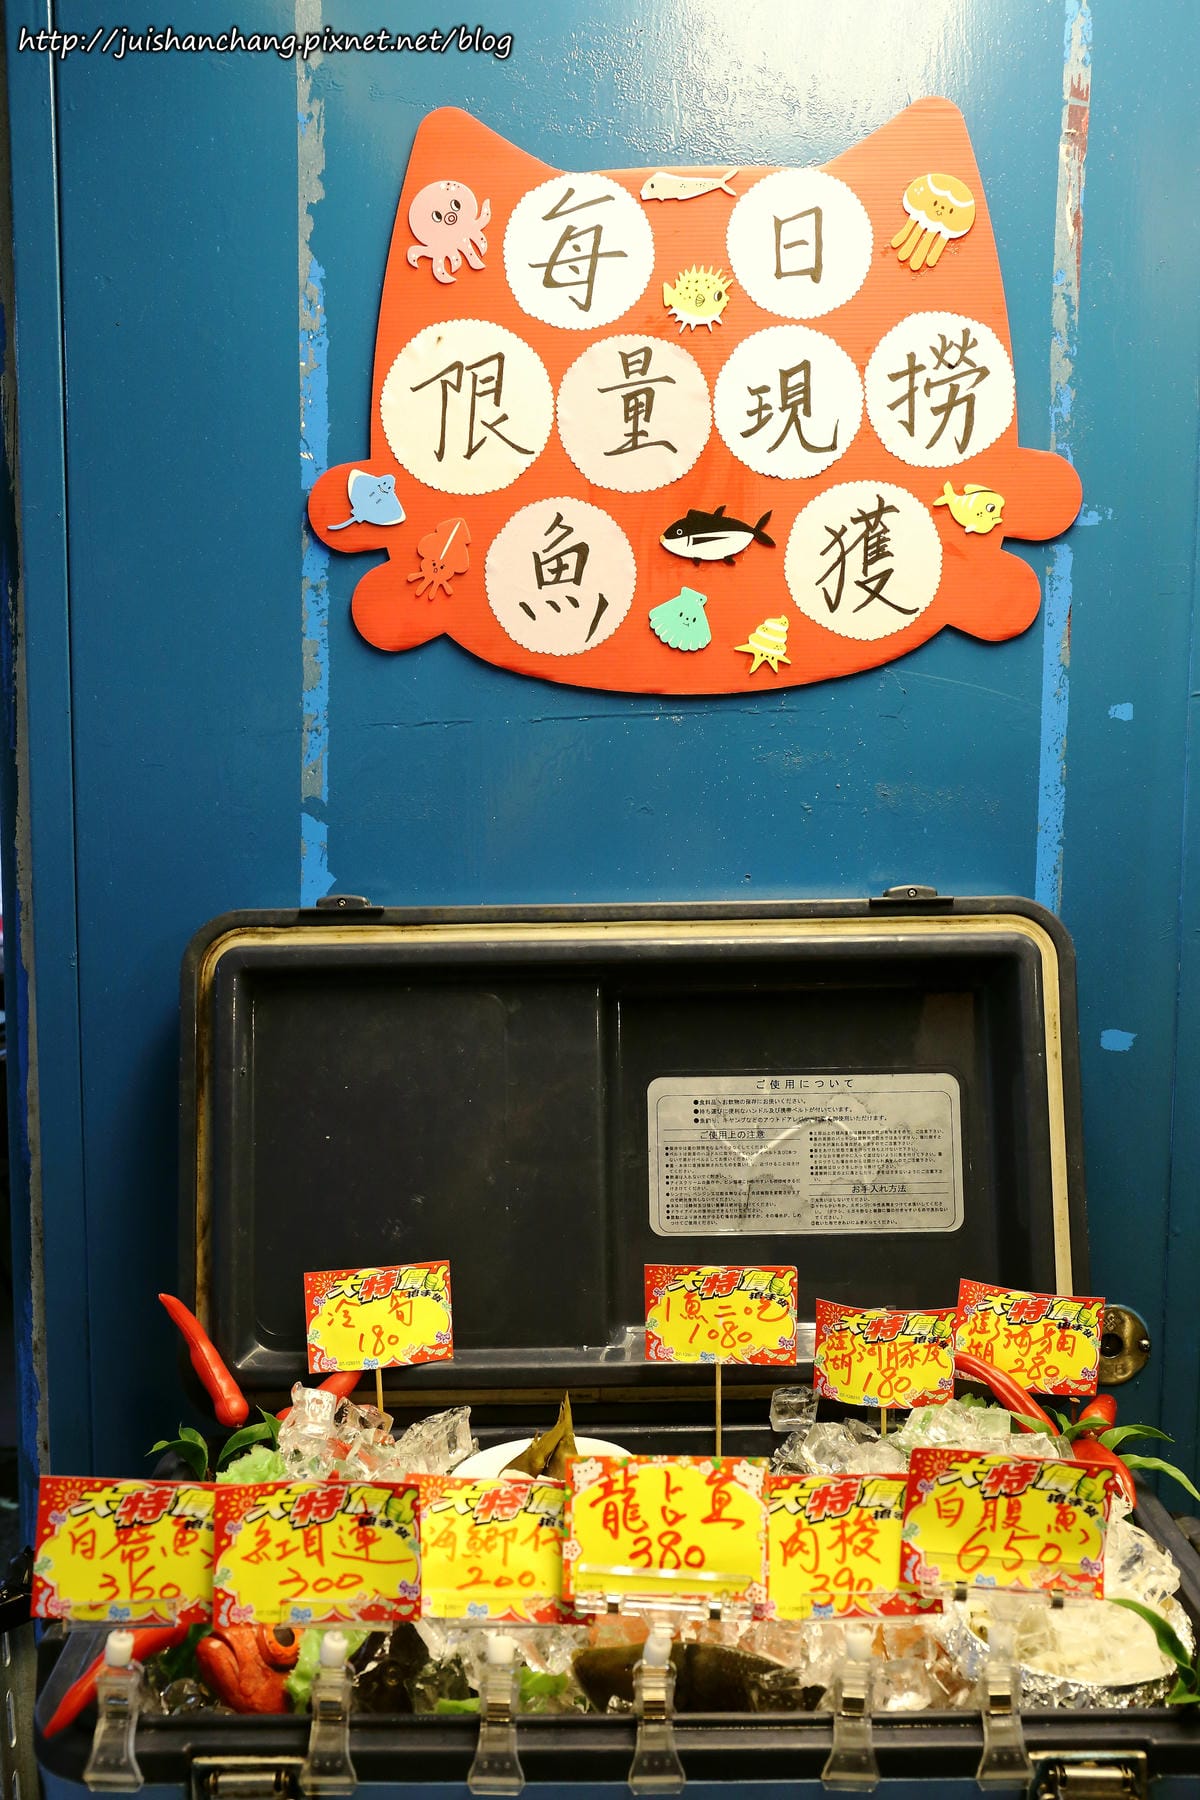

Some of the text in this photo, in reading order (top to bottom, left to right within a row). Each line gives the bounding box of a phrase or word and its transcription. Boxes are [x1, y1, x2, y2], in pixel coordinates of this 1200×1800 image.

[410, 328, 992, 462] 限量現撈
[756, 1079, 855, 1090] ご使用について
[700, 1130, 767, 1140] ご使用上の注意
[851, 1184, 907, 1194] お手入れ方法
[326, 1268, 431, 1305] 大特價
[667, 1270, 777, 1300] 大特價
[976, 1294, 1085, 1326] 大特價
[358, 1324, 400, 1357] 180
[688, 1320, 753, 1349] 1080
[833, 1314, 939, 1344] 大特價
[862, 1366, 912, 1399] 180
[1007, 1355, 1060, 1381] 280
[936, 1461, 1089, 1499] 大特價
[68, 1486, 216, 1530] 大特價
[244, 1485, 394, 1530] 大特價
[430, 1484, 565, 1525] 大特價
[769, 1479, 908, 1524] 大特價
[628, 1530, 706, 1571] 380
[956, 1526, 1063, 1574] 650
[98, 1565, 182, 1611] 360
[278, 1567, 364, 1606] 300
[809, 1567, 874, 1613] 390
